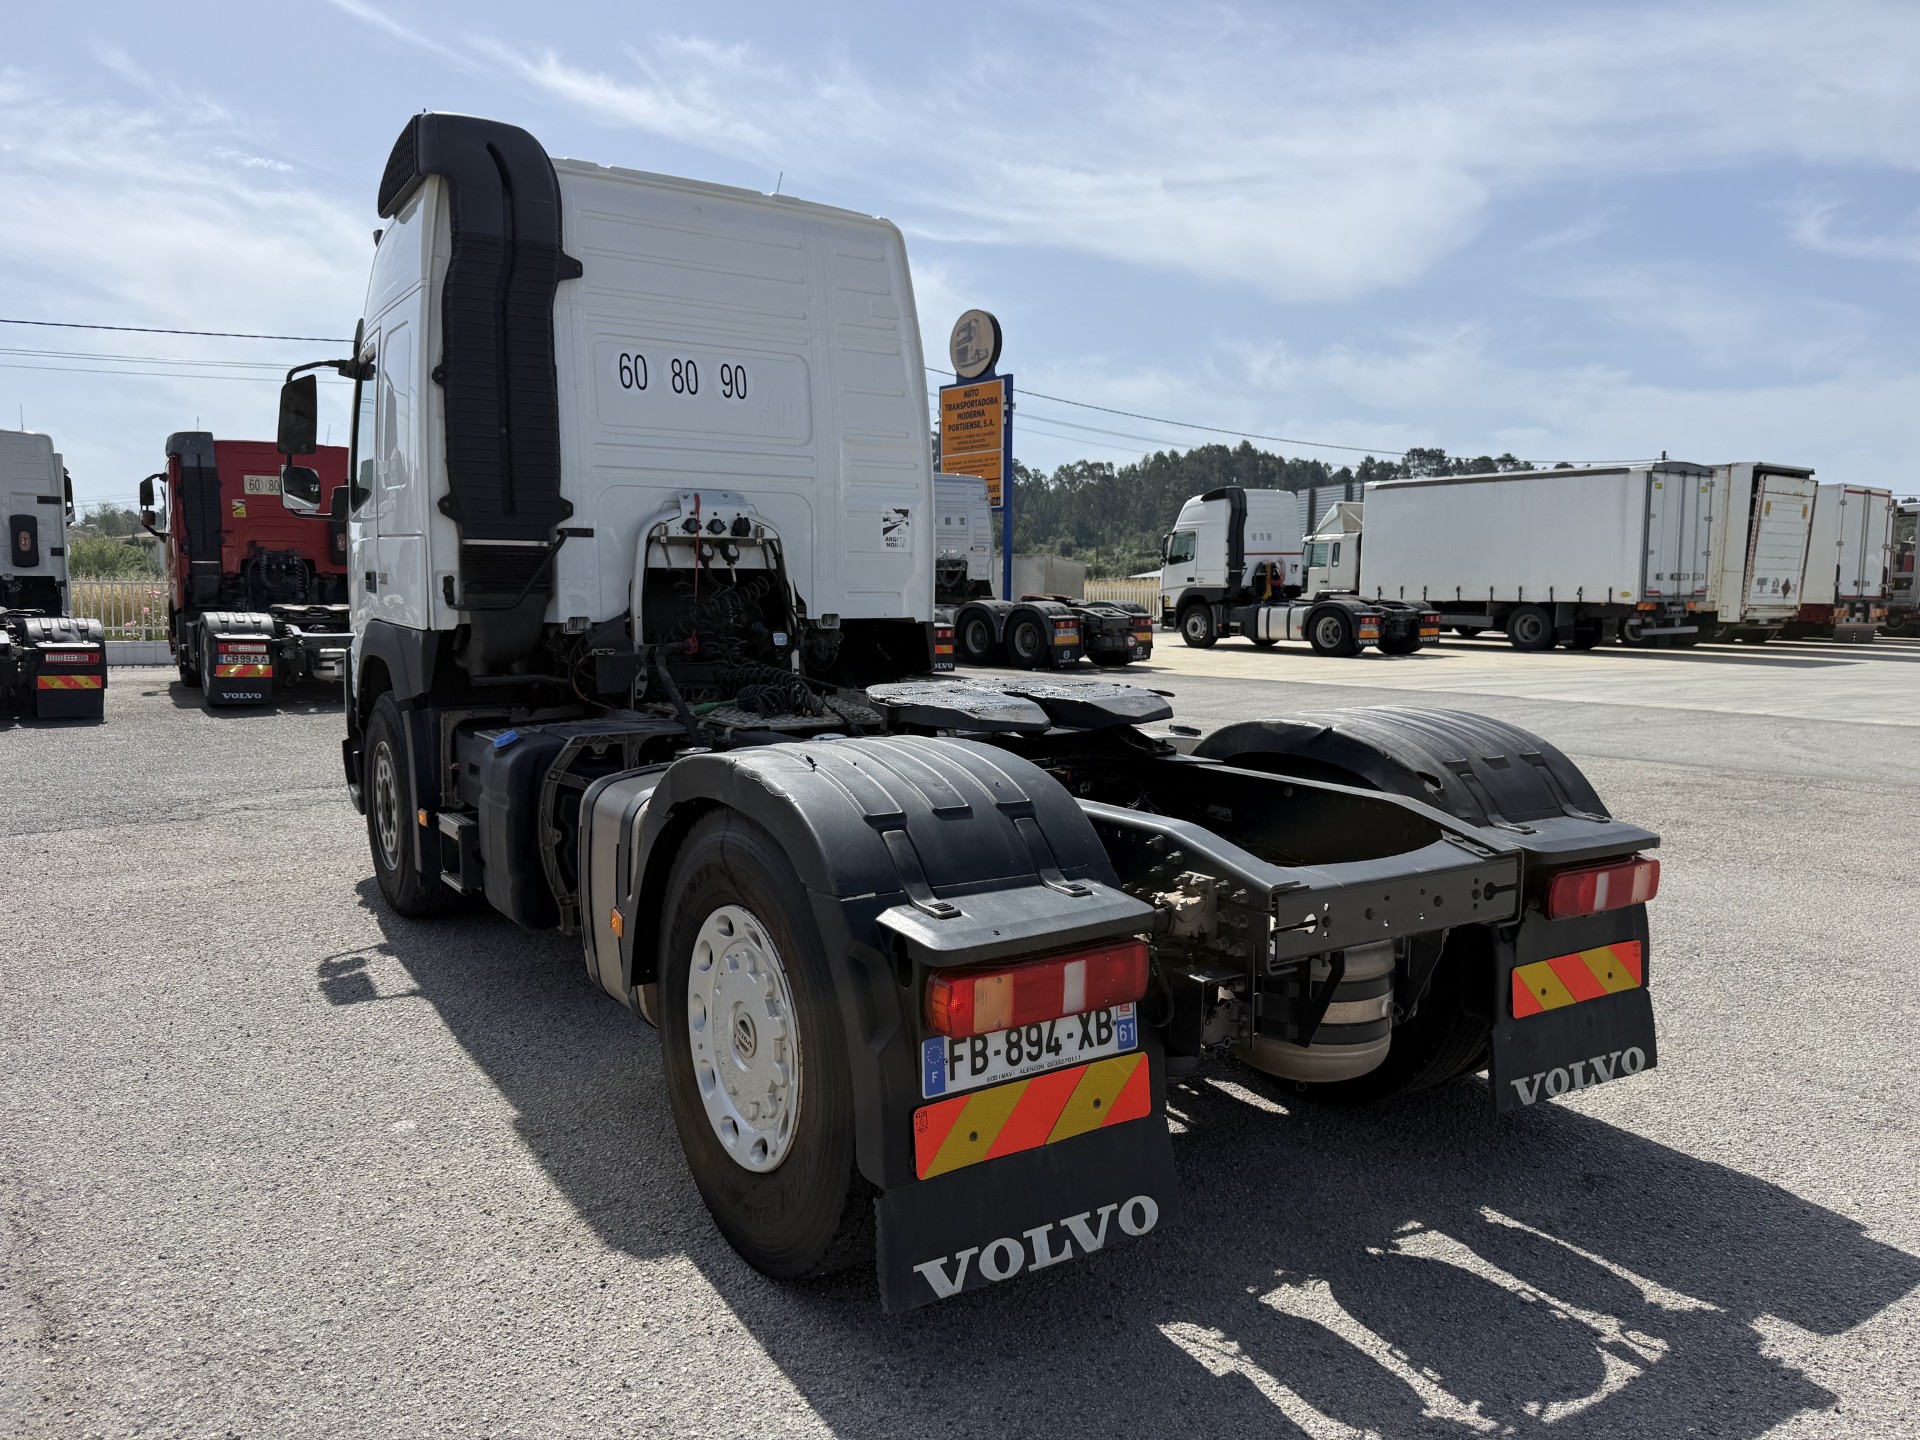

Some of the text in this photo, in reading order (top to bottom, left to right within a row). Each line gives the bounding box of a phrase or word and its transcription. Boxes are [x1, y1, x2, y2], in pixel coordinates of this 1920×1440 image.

[619, 352, 747, 400] 60 80 90
[963, 388, 979, 398] AUTO
[945, 396, 998, 412] TRANSPORTADORA
[957, 409, 985, 420] MODERNA
[249, 478, 279, 492] 60 80
[949, 1008, 1134, 1081] FB-894-XB 61
[931, 1070, 938, 1084] F
[1511, 1046, 1646, 1106] VOLVO
[913, 1194, 1159, 1299] VOLVO
